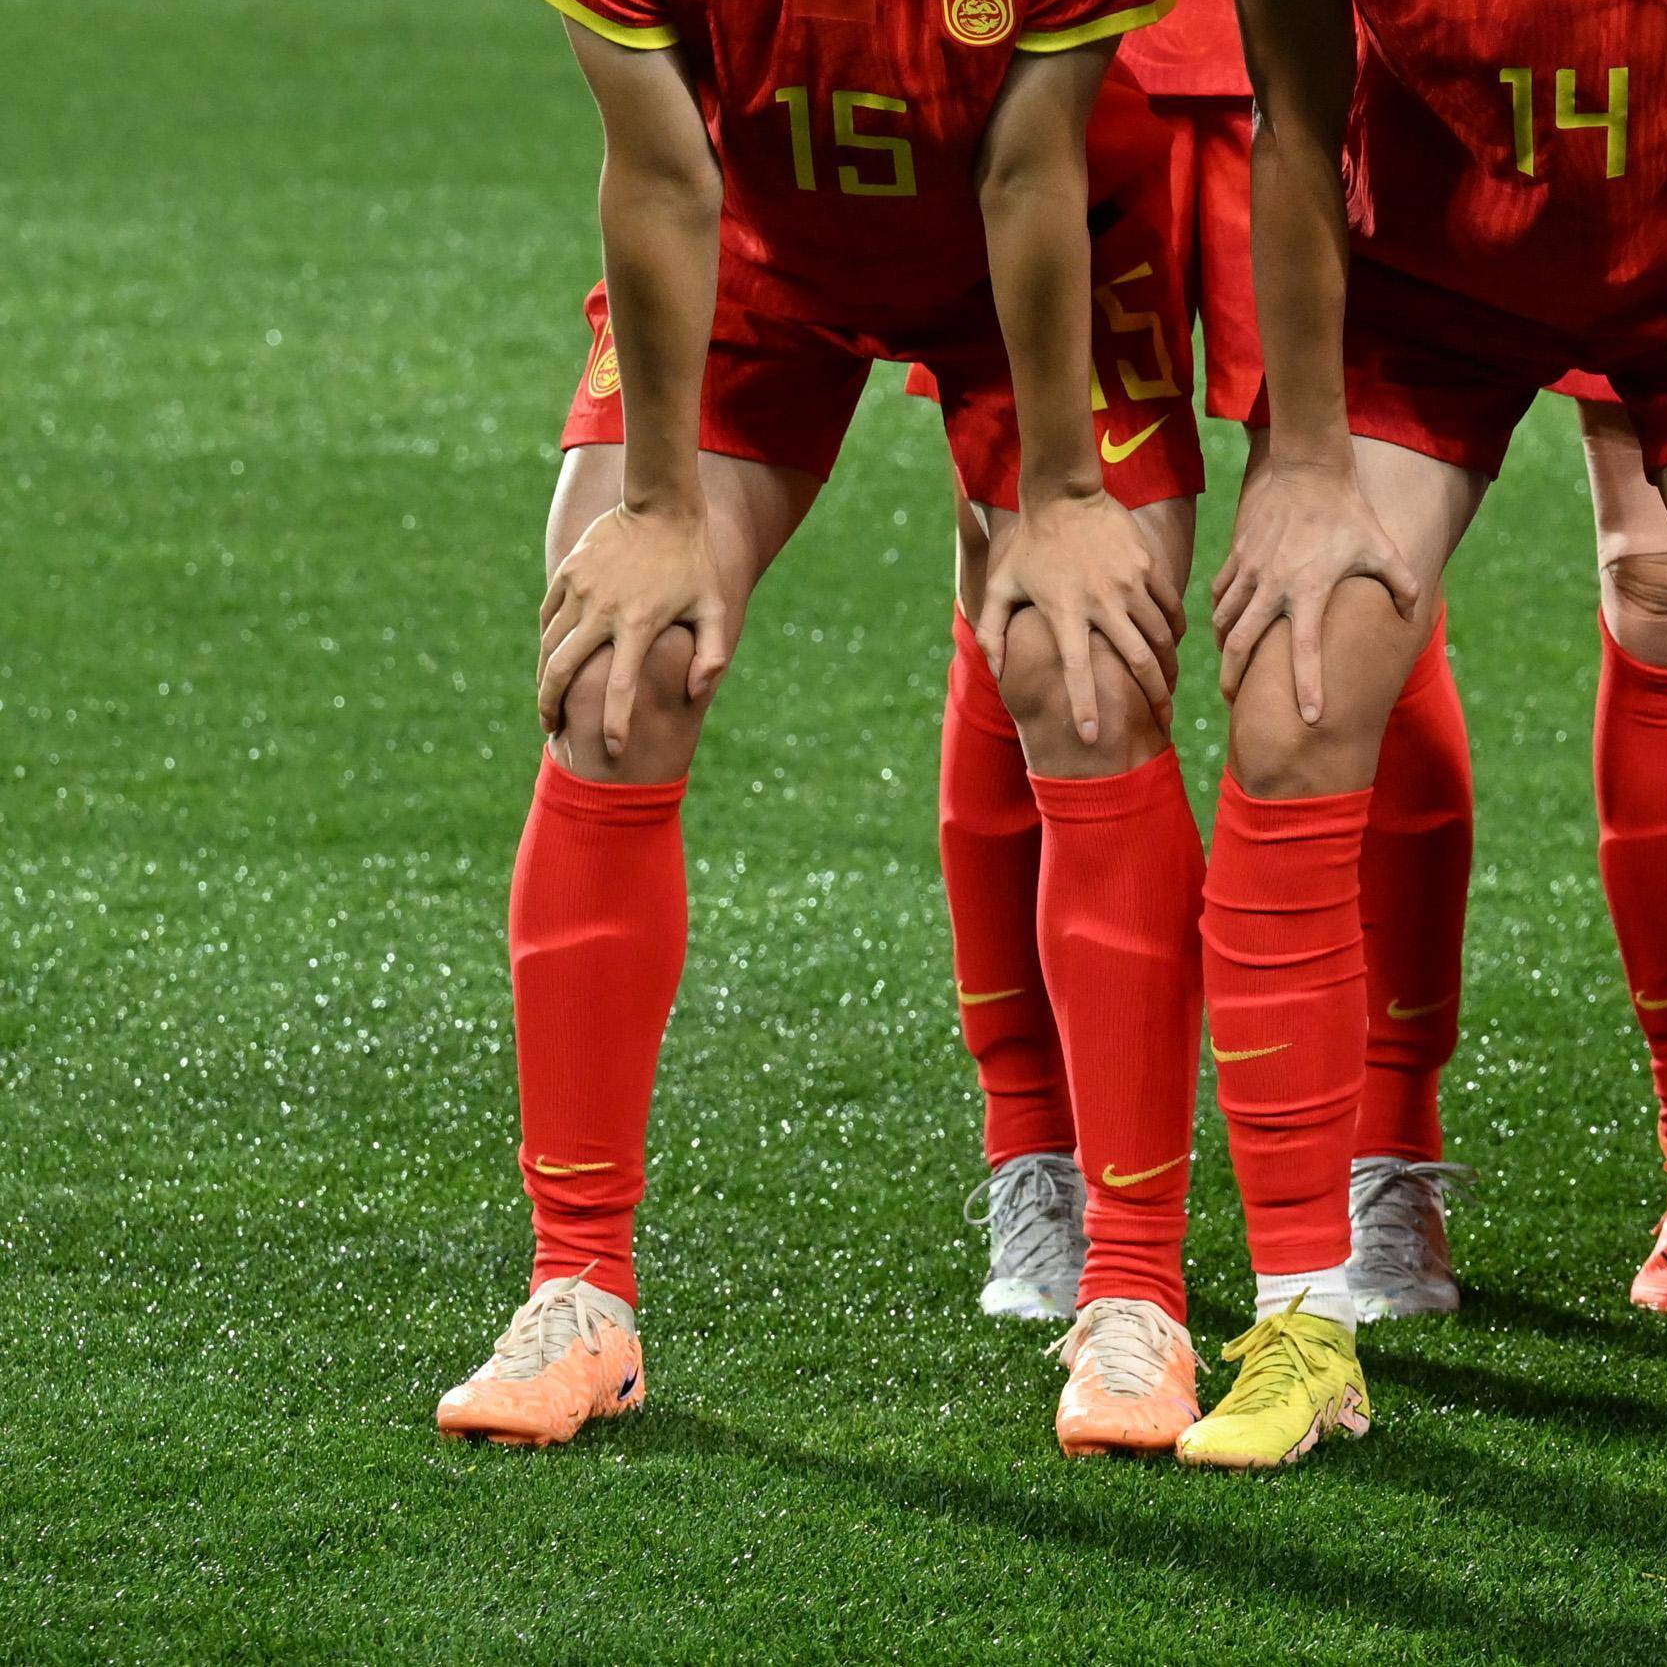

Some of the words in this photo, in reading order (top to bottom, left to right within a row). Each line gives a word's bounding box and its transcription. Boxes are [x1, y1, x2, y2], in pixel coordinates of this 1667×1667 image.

[775, 85, 918, 196] 15
[1499, 67, 1629, 178] 14
[1090, 260, 1183, 411] 5
